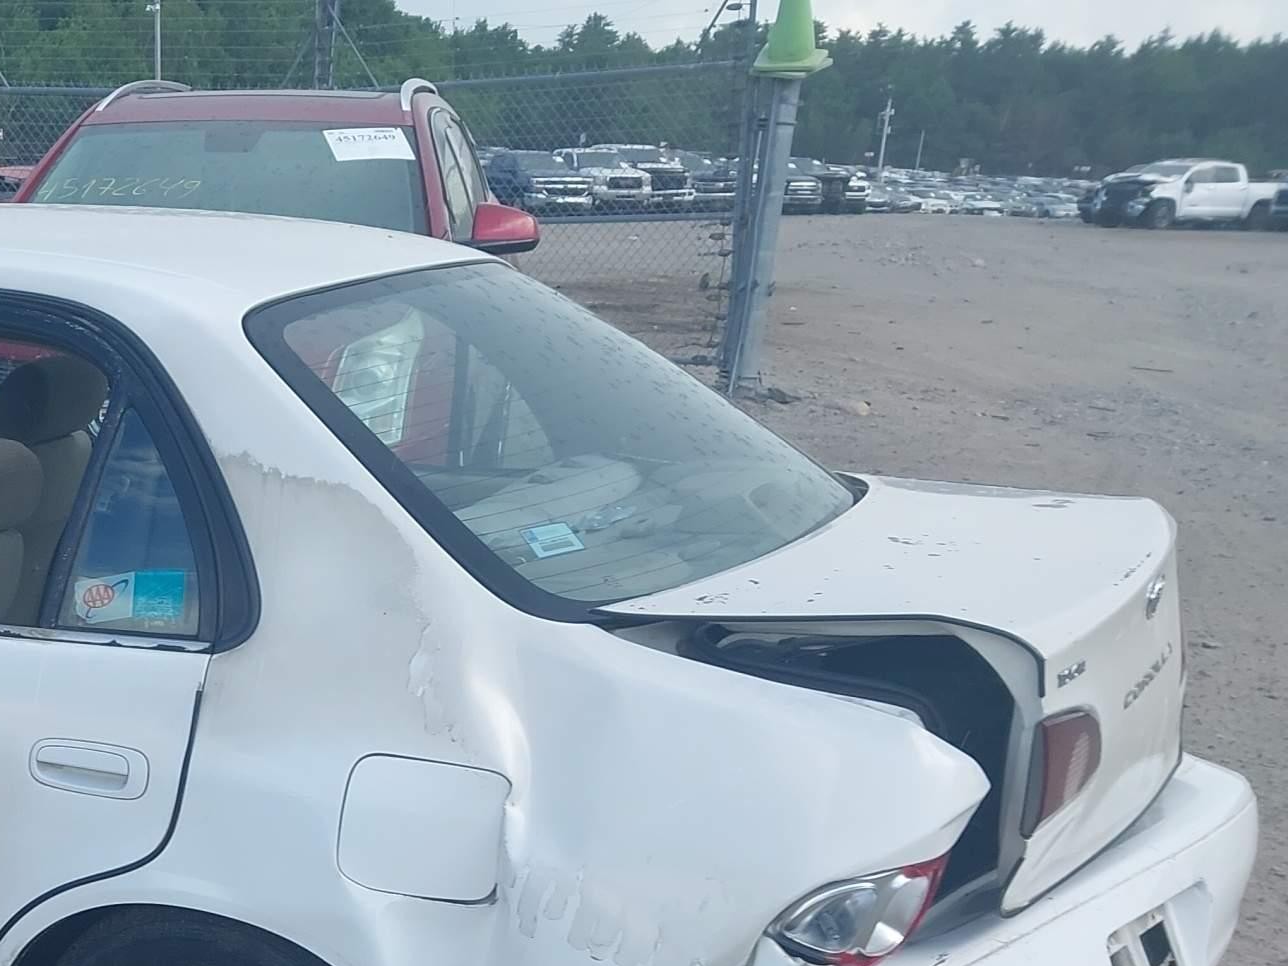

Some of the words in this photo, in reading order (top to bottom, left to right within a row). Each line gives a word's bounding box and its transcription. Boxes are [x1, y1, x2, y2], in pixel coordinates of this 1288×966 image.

[335, 133, 397, 144] 45172649
[36, 176, 202, 202] 45172649
[86, 586, 110, 602] AAA
